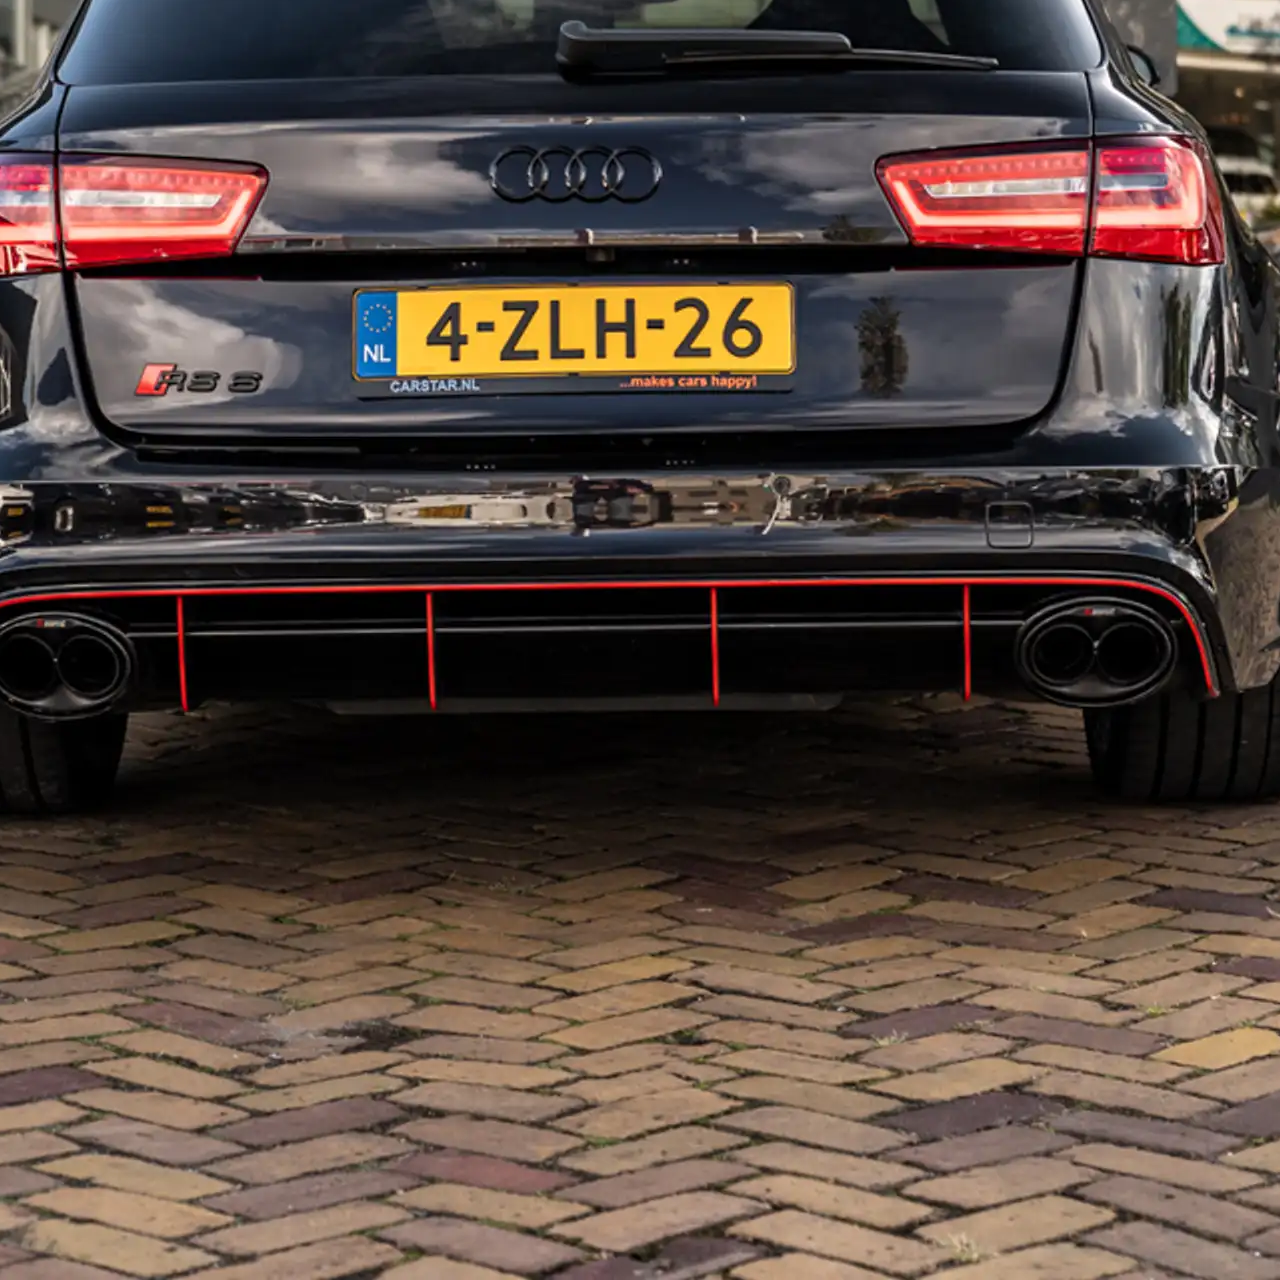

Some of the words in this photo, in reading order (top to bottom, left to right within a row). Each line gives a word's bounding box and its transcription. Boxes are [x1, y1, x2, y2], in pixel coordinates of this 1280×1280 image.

[426, 297, 763, 362] 4-ZLH-26
[363, 343, 392, 363] NL
[389, 378, 481, 394] CARSTAR.NL
[677, 375, 708, 388] cars
[710, 374, 758, 390] happy!
